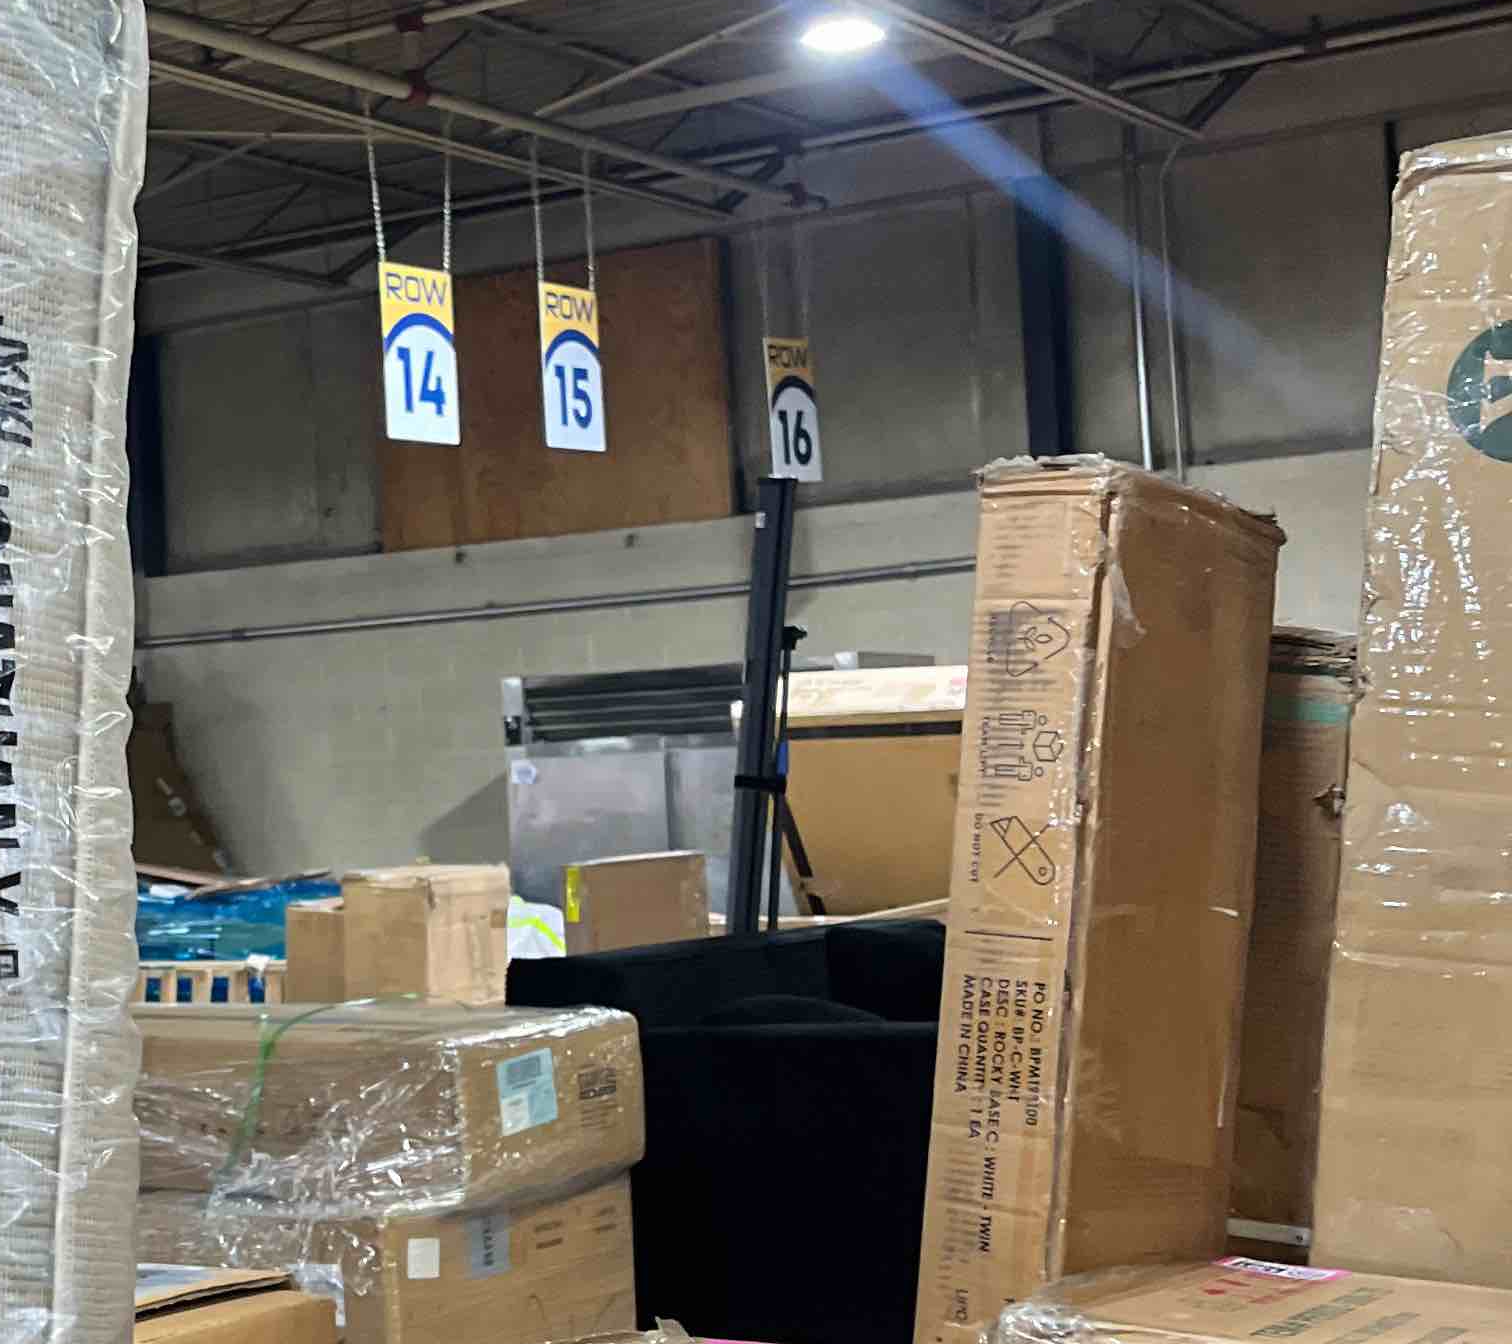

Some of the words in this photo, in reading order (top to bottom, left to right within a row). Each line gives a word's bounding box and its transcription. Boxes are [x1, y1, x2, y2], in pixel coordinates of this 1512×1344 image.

[385, 272, 448, 306] ROW
[546, 291, 595, 324] ROW
[767, 343, 808, 369] ROW
[397, 347, 446, 416] 14
[554, 365, 593, 429] 15
[778, 409, 812, 465] 16
[961, 974, 976, 1020] MADE
[979, 976, 993, 1017] CASE
[1033, 982, 1046, 1004] PO
[961, 1023, 972, 1039] IN
[954, 1043, 970, 1094] CHINA
[991, 1030, 1007, 1085] ROCKY
[987, 1090, 1002, 1128] BASE
[968, 1120, 982, 1138] EA
[982, 1156, 997, 1200] WHITE
[978, 1216, 992, 1252] TWIN
